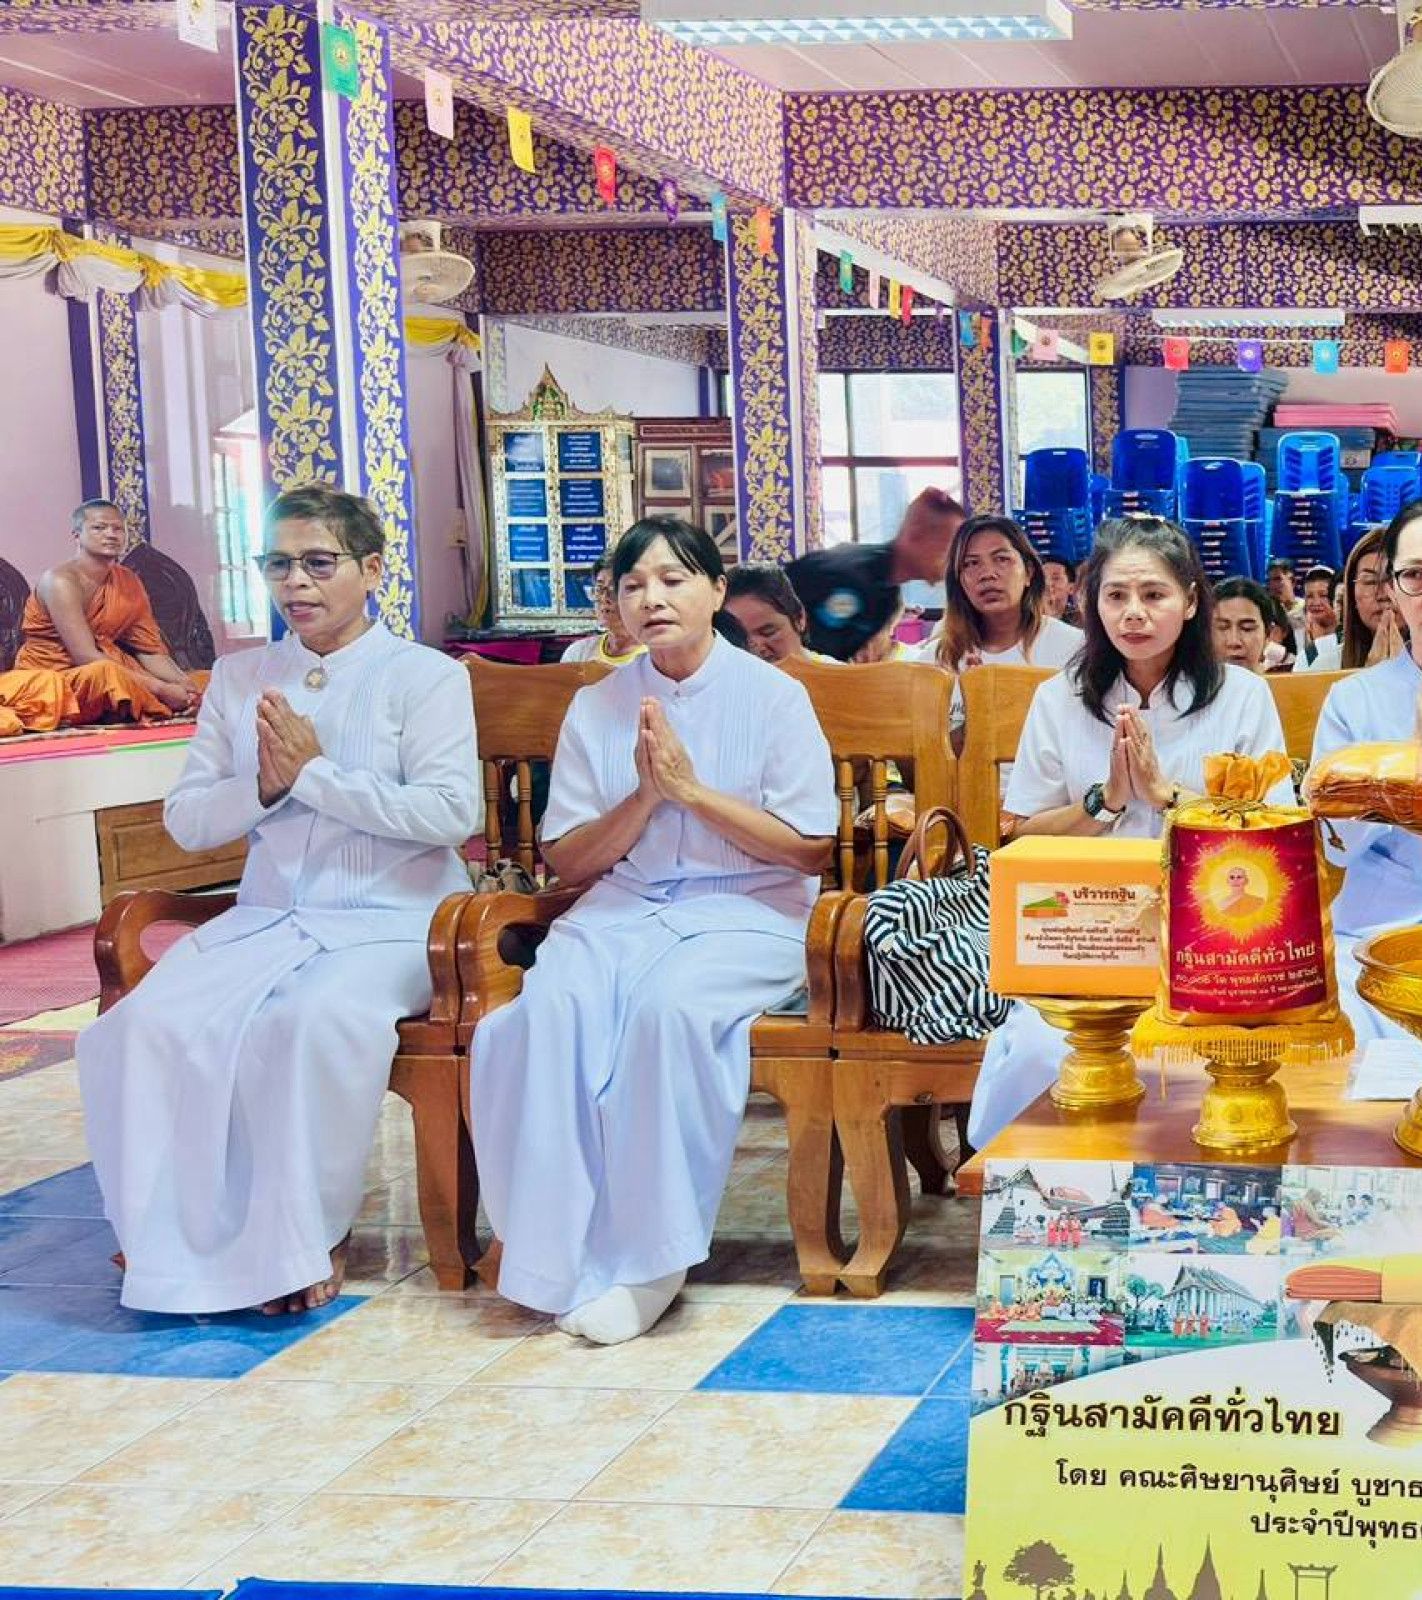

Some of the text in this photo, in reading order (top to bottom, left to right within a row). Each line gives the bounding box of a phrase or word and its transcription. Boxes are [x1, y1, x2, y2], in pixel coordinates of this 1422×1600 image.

[1073, 887, 1135, 902] บริวารกฐิน
[1004, 1386, 1340, 1438] กฐินสามัคคีทั่วไทย
[1056, 1458, 1107, 1486] โดย
[1119, 1463, 1340, 1503] คณะศิษยานุศิษย์
